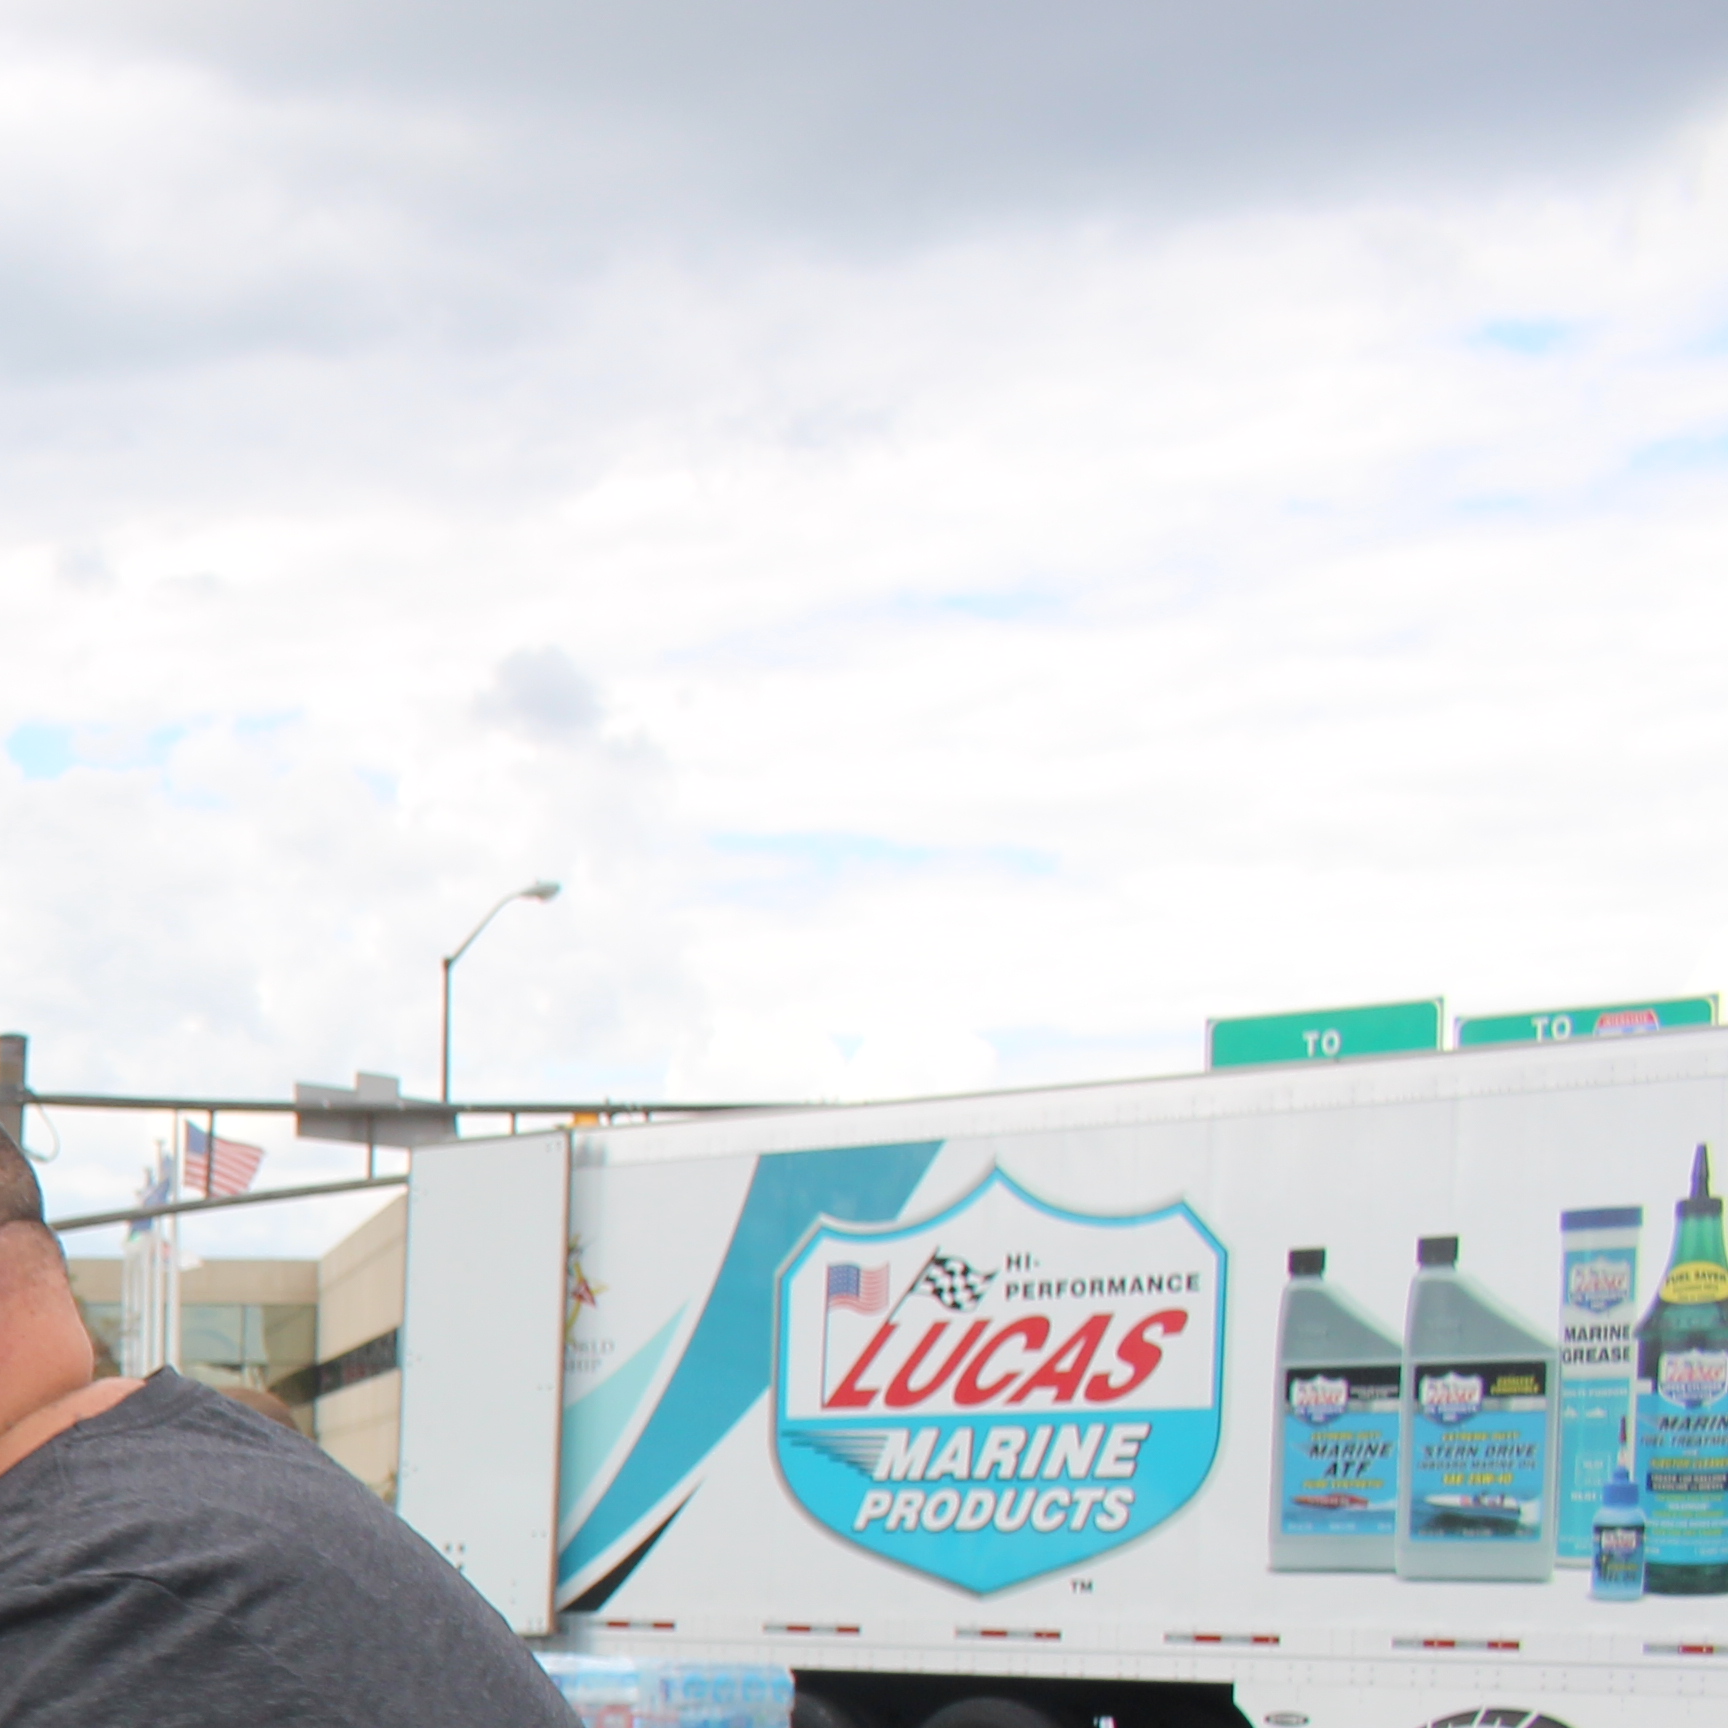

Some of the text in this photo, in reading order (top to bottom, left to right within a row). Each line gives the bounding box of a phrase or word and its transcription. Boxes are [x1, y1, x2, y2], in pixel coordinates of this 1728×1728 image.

[1531, 1016, 1572, 1041] TO
[1303, 1029, 1341, 1056] TO
[1006, 1254, 1041, 1273] HI-
[1006, 1273, 1201, 1301] PERFORMANCE
[1563, 1325, 1631, 1343] MARINE
[822, 1307, 1189, 1411] LUCAS
[1562, 1347, 1631, 1364] GREASE
[872, 1423, 1152, 1482] MARINE
[1309, 1441, 1392, 1459] MARINE
[853, 1486, 1136, 1533] PRODUCTS
